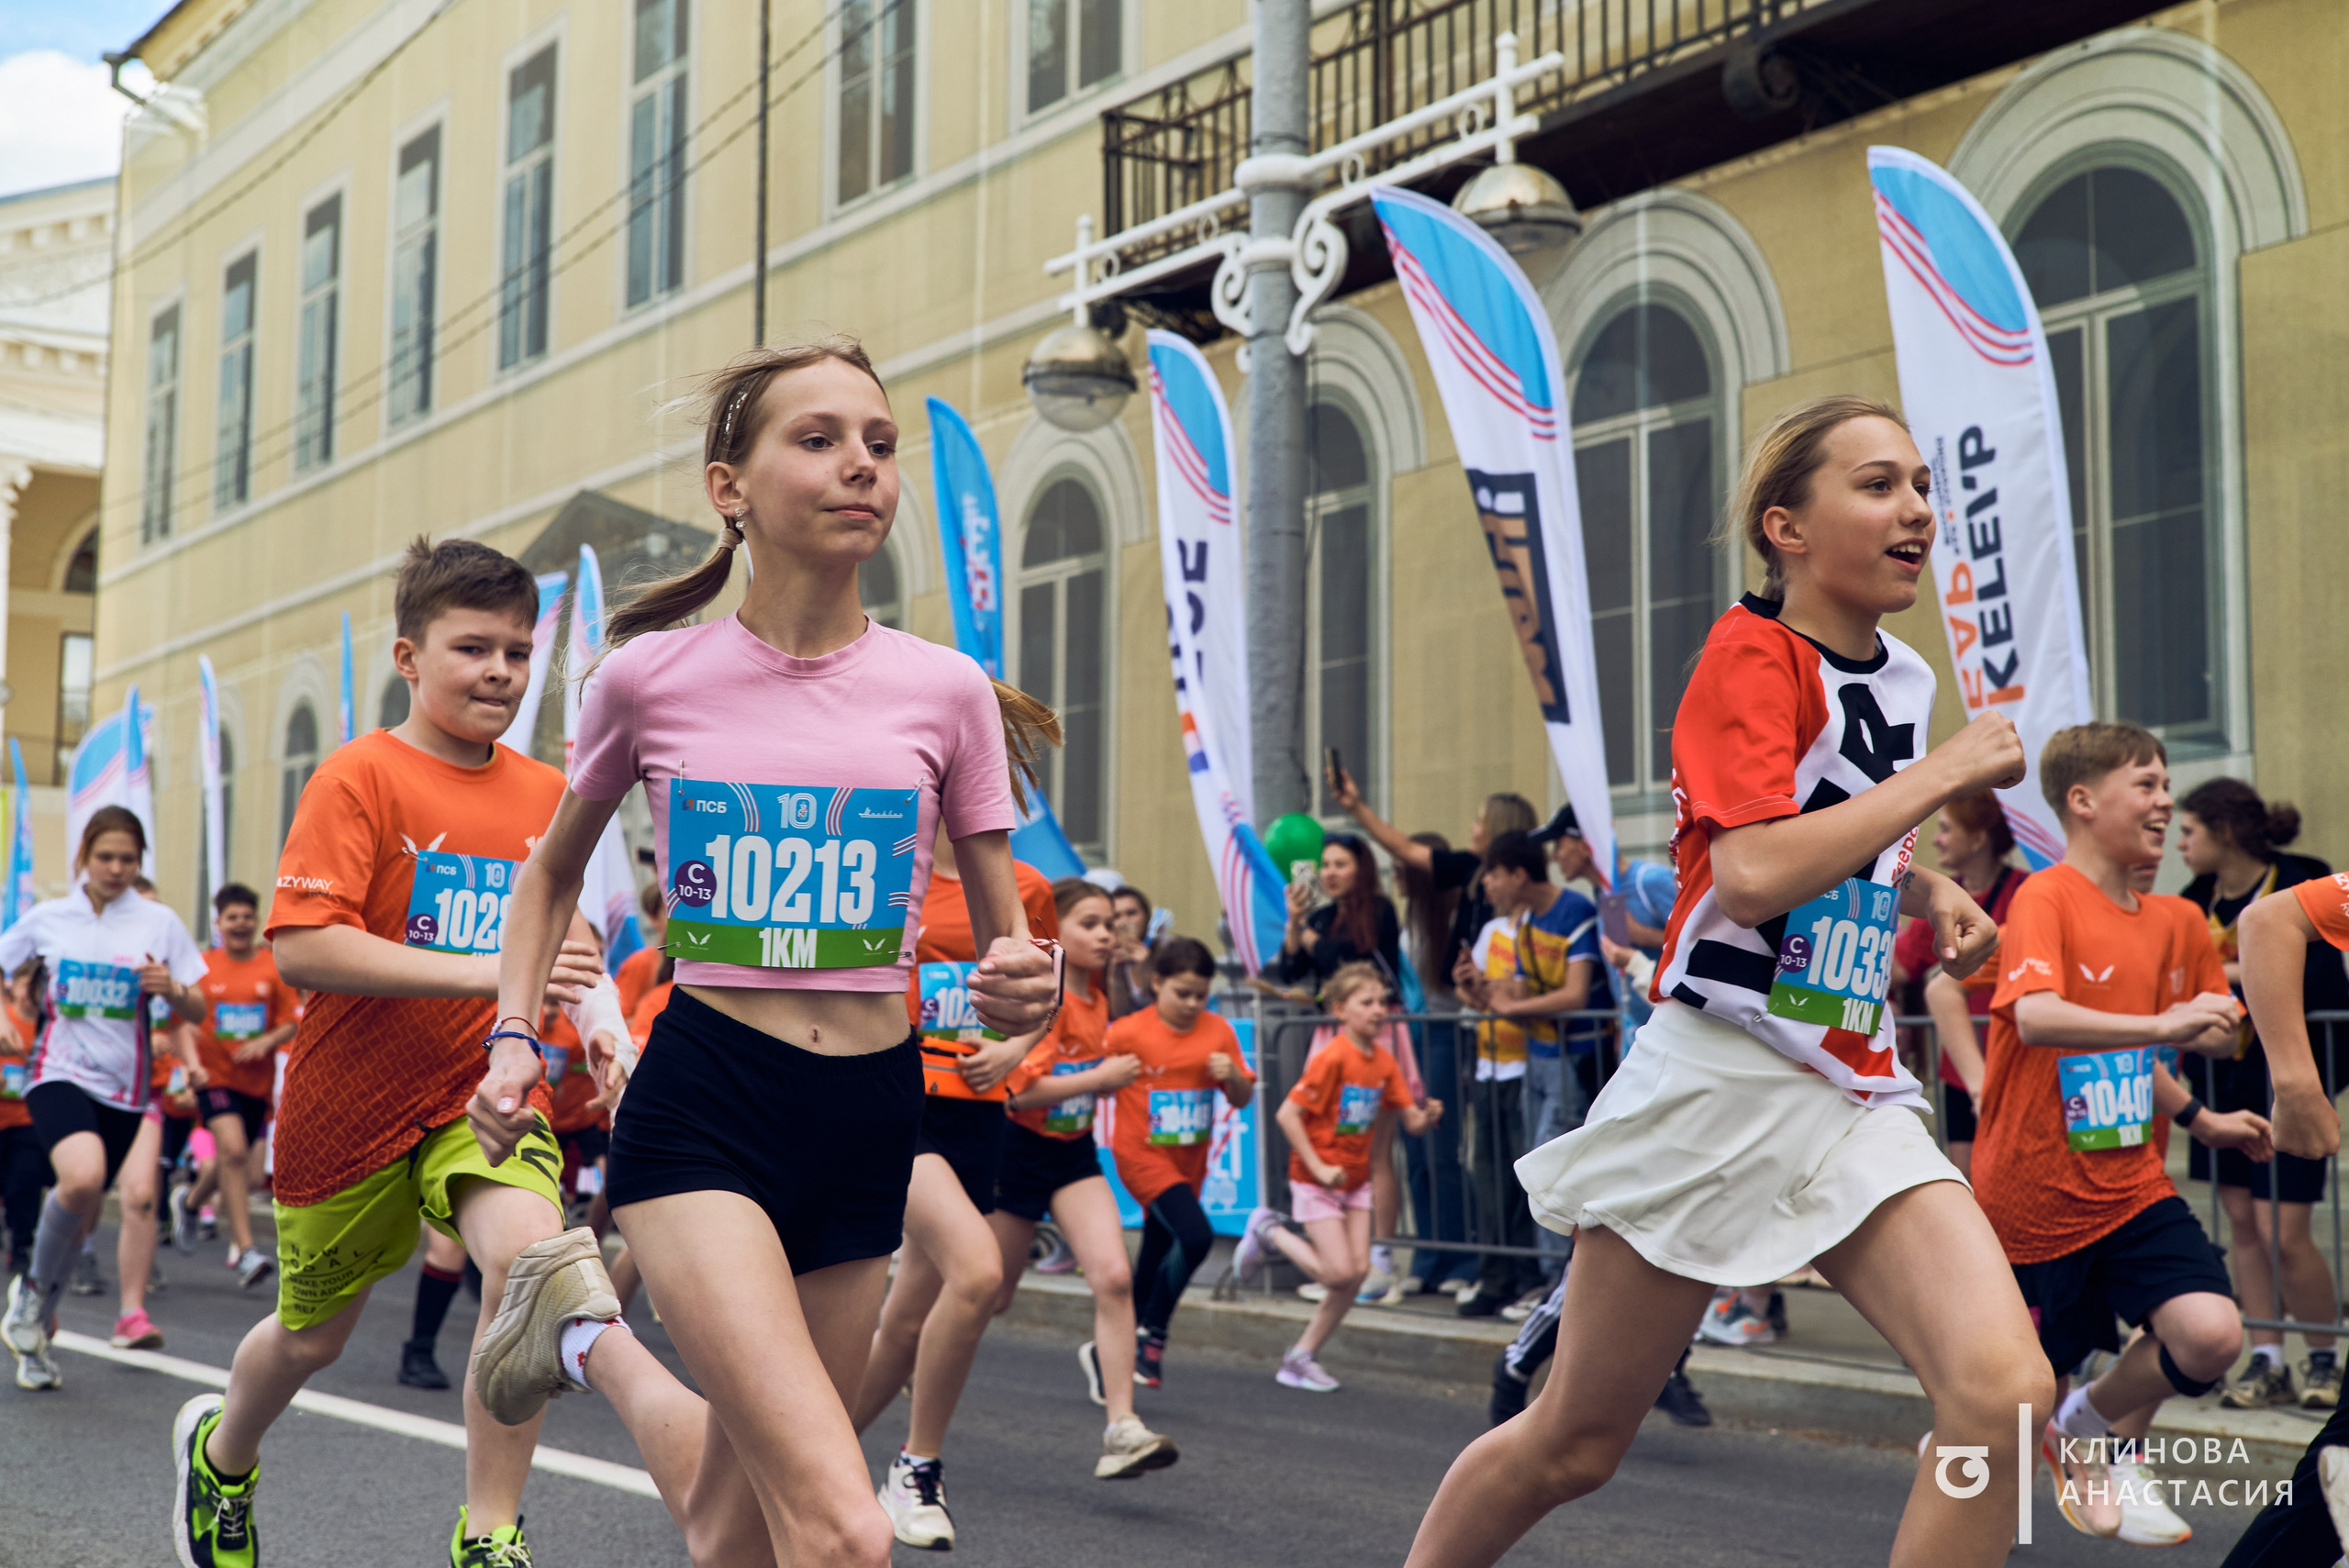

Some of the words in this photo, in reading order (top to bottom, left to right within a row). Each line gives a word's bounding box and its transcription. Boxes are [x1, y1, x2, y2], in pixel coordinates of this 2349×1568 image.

[696, 799, 728, 814] ПСБ
[777, 793, 817, 829] 10
[437, 865, 457, 875] ПСБ
[484, 862, 506, 888] 10
[688, 863, 705, 884] C
[706, 834, 877, 924] 10213
[679, 884, 712, 901] 10-13
[1820, 890, 1839, 900] СБ
[1871, 891, 1891, 921] 10
[417, 916, 431, 930] C
[408, 929, 434, 941] 10-13
[1790, 937, 1804, 953] C
[1781, 954, 1807, 968] 10-13
[321, 1270, 354, 1286] YOUR
[293, 1286, 317, 1297] OWN
